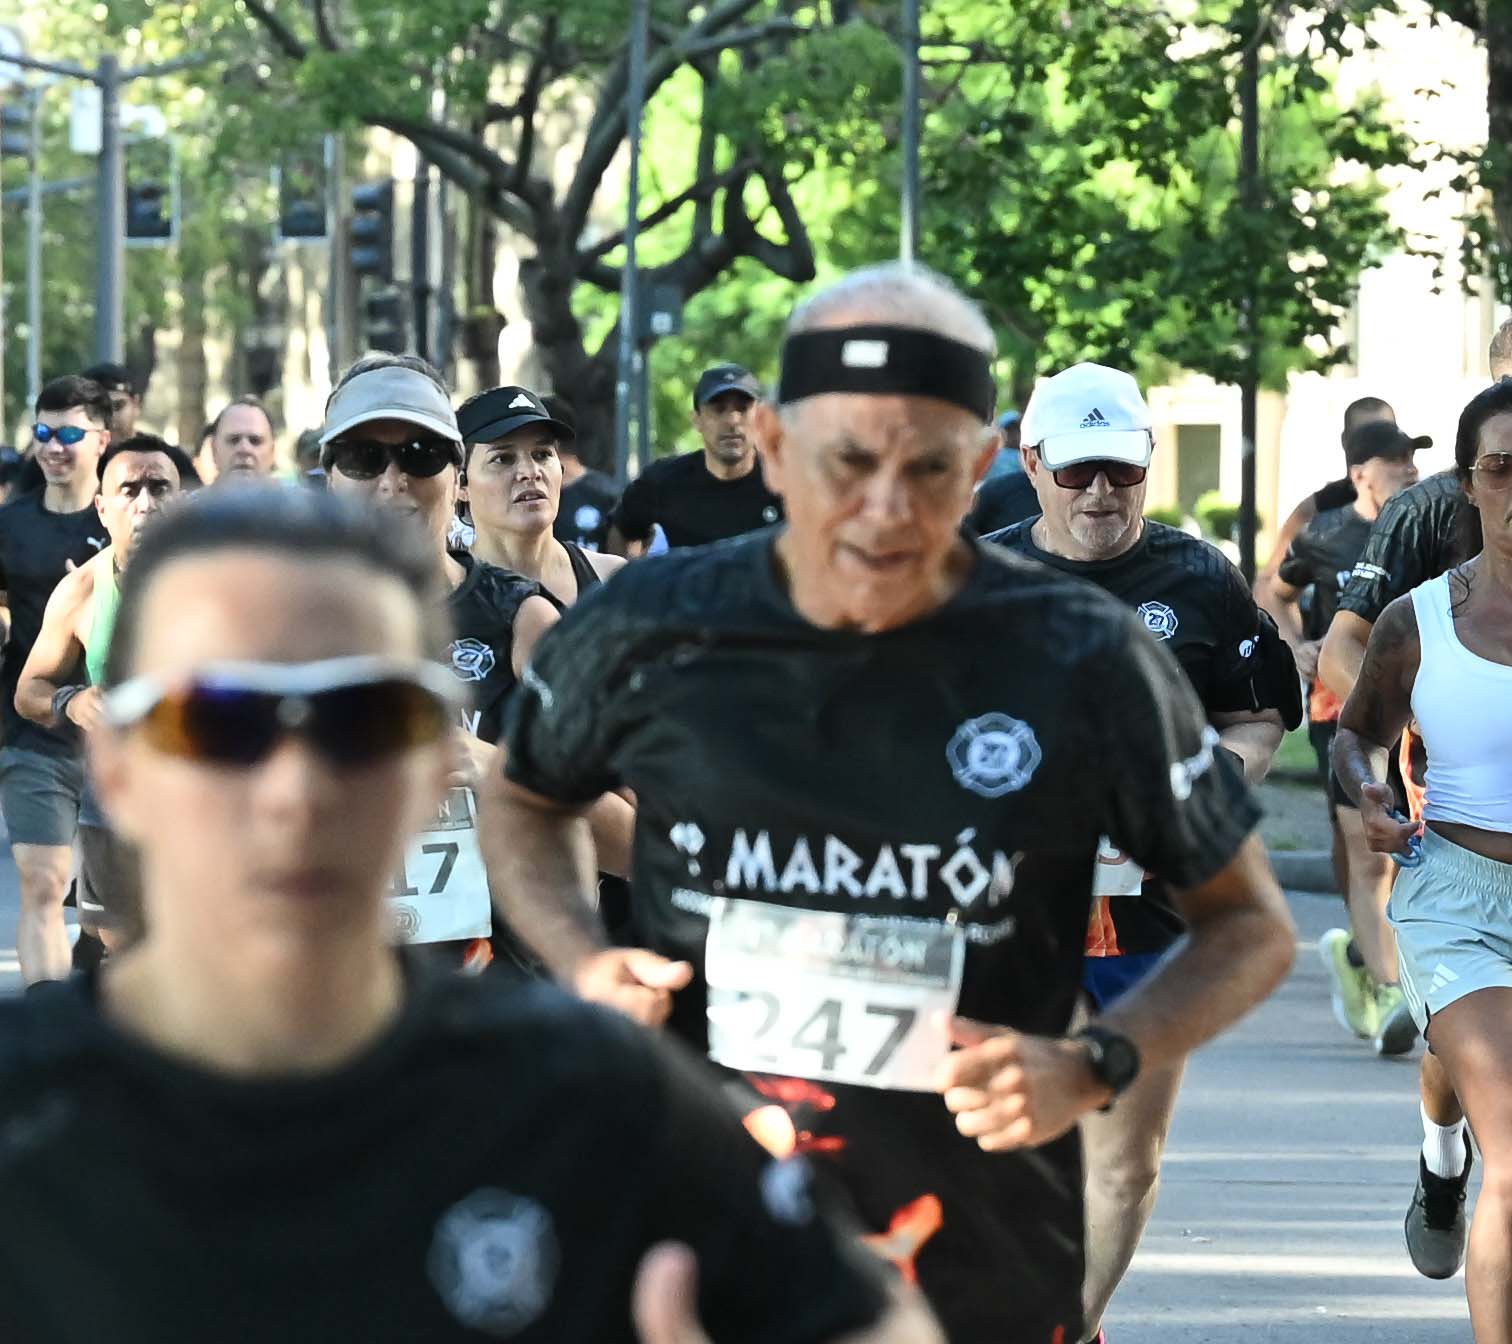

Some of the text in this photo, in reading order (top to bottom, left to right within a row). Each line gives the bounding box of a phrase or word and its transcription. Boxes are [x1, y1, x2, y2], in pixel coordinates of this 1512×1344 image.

[1079, 420, 1111, 429] adidas
[1147, 612, 1164, 627] 27
[725, 825, 1024, 907] MARATÓN
[734, 988, 919, 1076] 247
